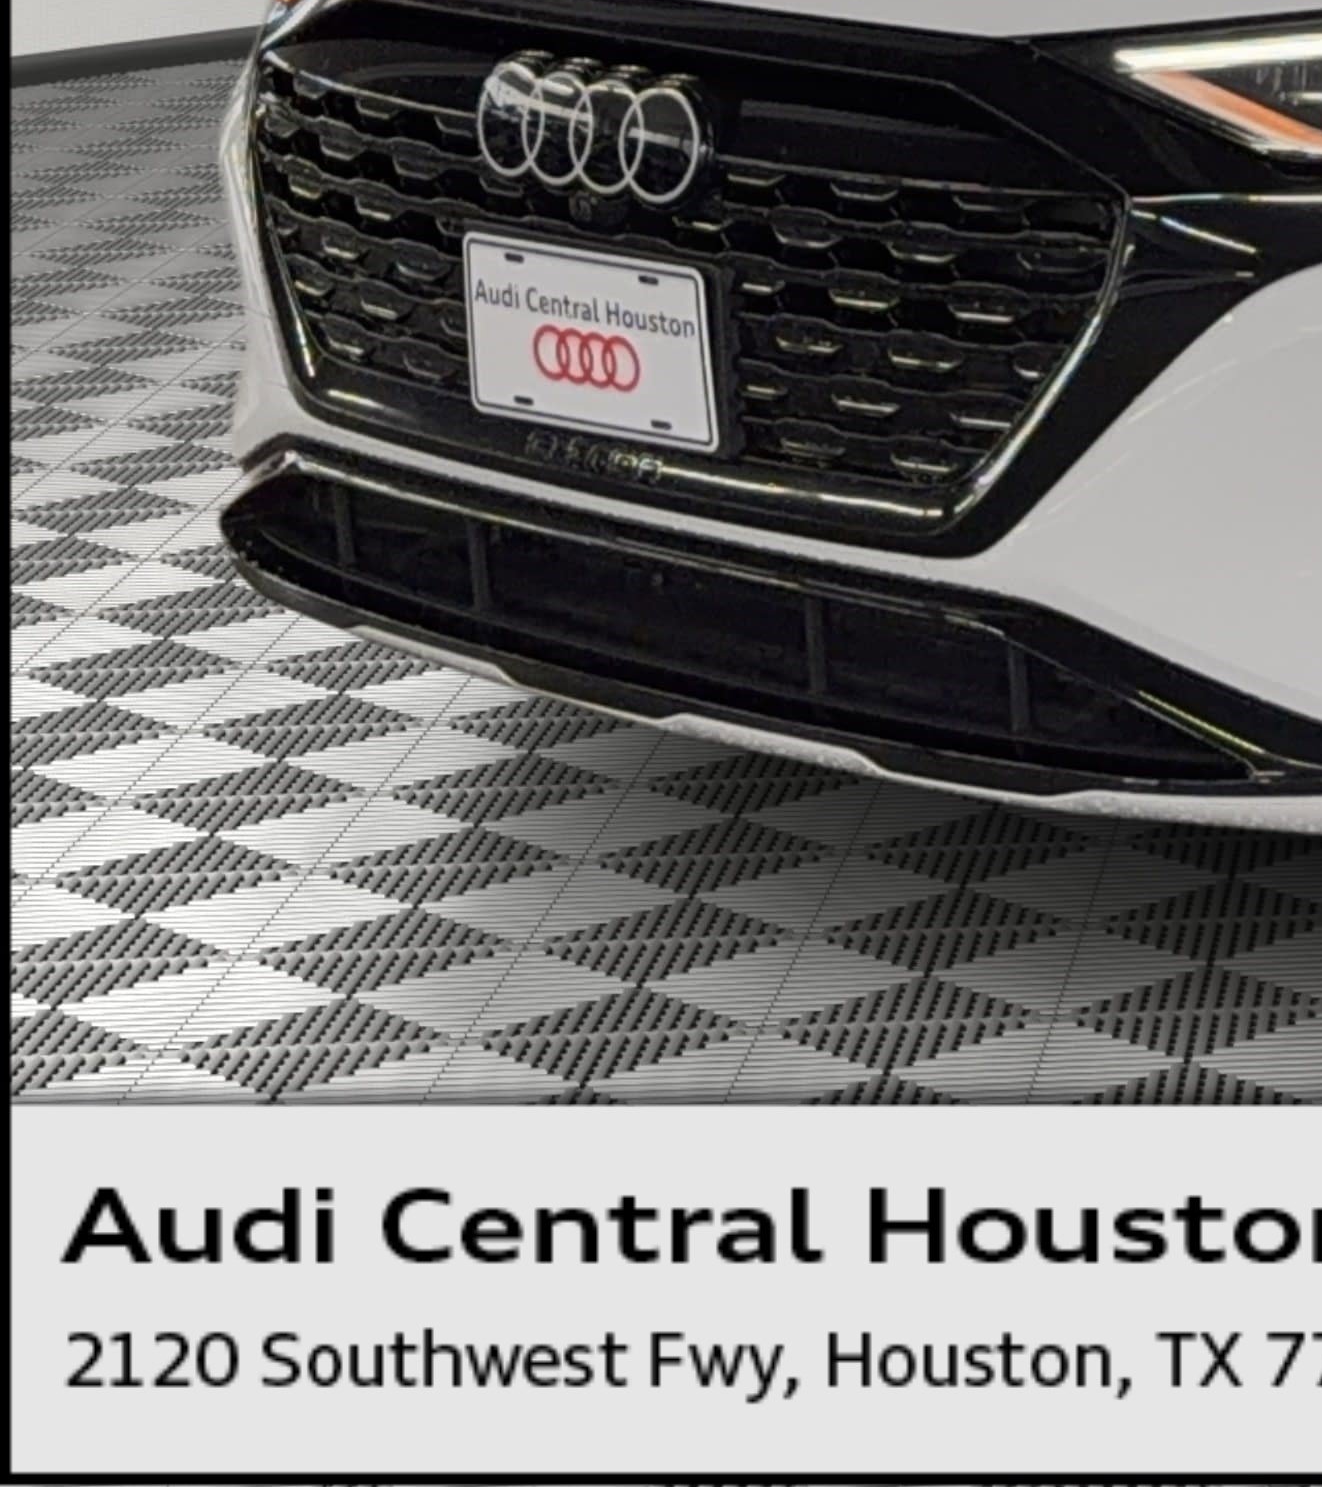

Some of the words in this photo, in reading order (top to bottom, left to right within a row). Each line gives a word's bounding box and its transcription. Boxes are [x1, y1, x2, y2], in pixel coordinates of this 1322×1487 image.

[474, 278, 521, 310] Audi
[525, 286, 601, 323] Central
[605, 300, 696, 339] Houston
